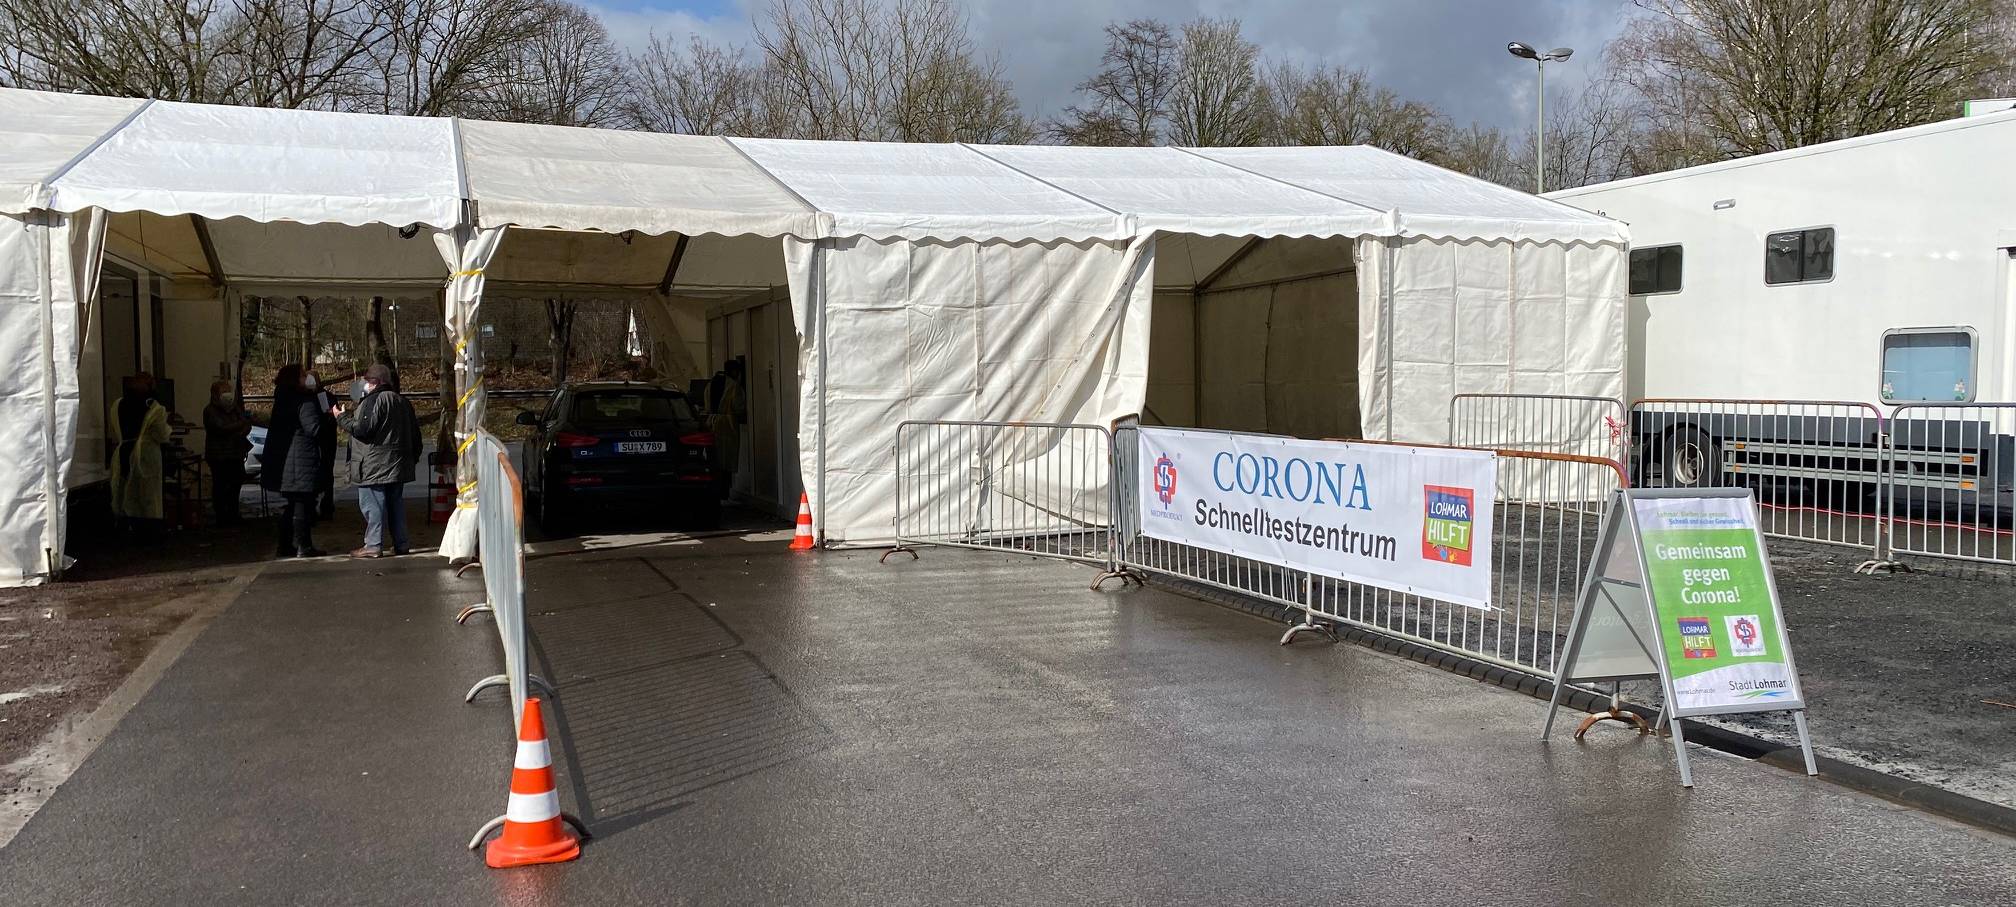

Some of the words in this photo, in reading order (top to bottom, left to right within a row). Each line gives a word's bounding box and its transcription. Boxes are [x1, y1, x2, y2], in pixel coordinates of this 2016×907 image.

[622, 443, 633, 452] SU
[646, 442, 662, 451] 789
[1213, 451, 1372, 511] CORONA
[1430, 501, 1467, 520] LOHMAR
[1195, 498, 1396, 562] Schnelltestzentrum
[1428, 520, 1468, 546] HILFT
[1655, 543, 1746, 561] Gemeinsam
[1683, 566, 1730, 585] gegen
[1681, 587, 1741, 604] Corona!
[1682, 624, 1709, 635] LOHMAR
[1685, 635, 1713, 650] HILFT
[1729, 680, 1753, 691] Stadt
[1754, 678, 1787, 690] Lohmar
